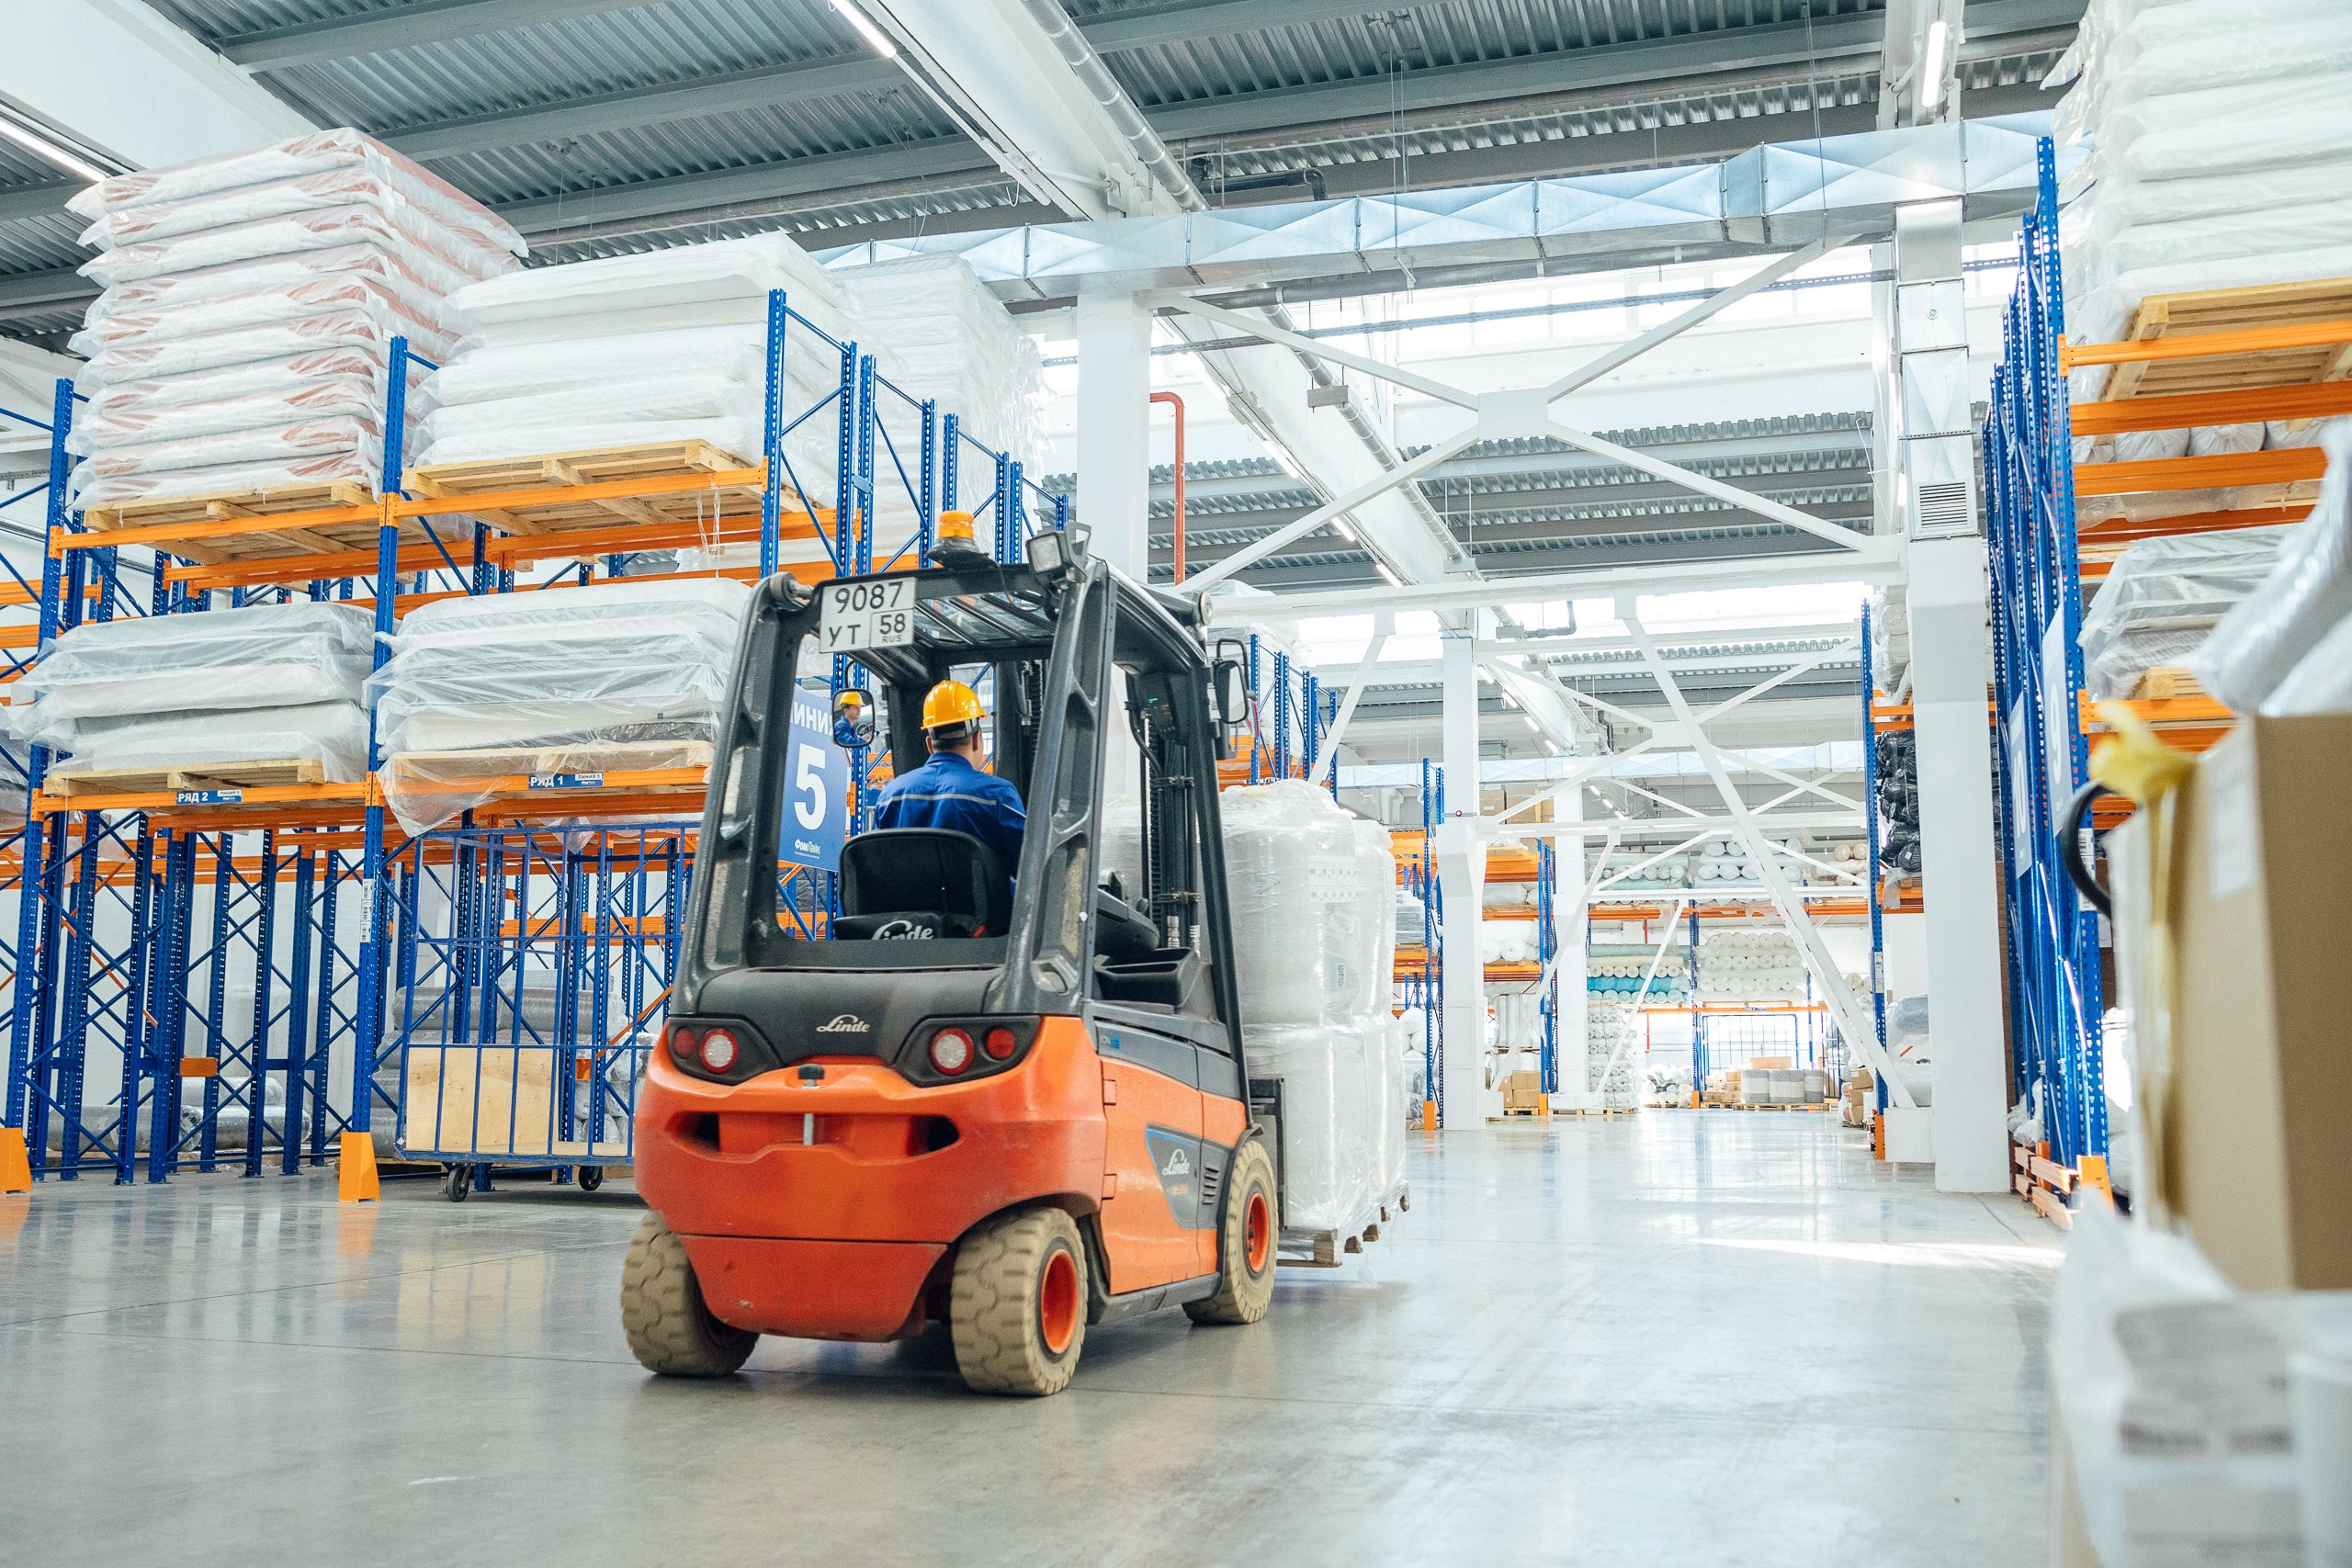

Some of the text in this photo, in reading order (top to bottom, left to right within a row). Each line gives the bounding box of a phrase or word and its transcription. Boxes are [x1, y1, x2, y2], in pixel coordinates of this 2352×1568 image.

[835, 581, 903, 614] 9087
[879, 613, 906, 635] 58
[882, 635, 903, 644] RUS
[790, 701, 833, 737] ИНИ
[558, 776, 563, 785] 1
[794, 742, 827, 830] 5
[179, 793, 209, 804] РЯД 2
[816, 1014, 871, 1032] Linde
[1161, 1148, 1191, 1176] Linde
